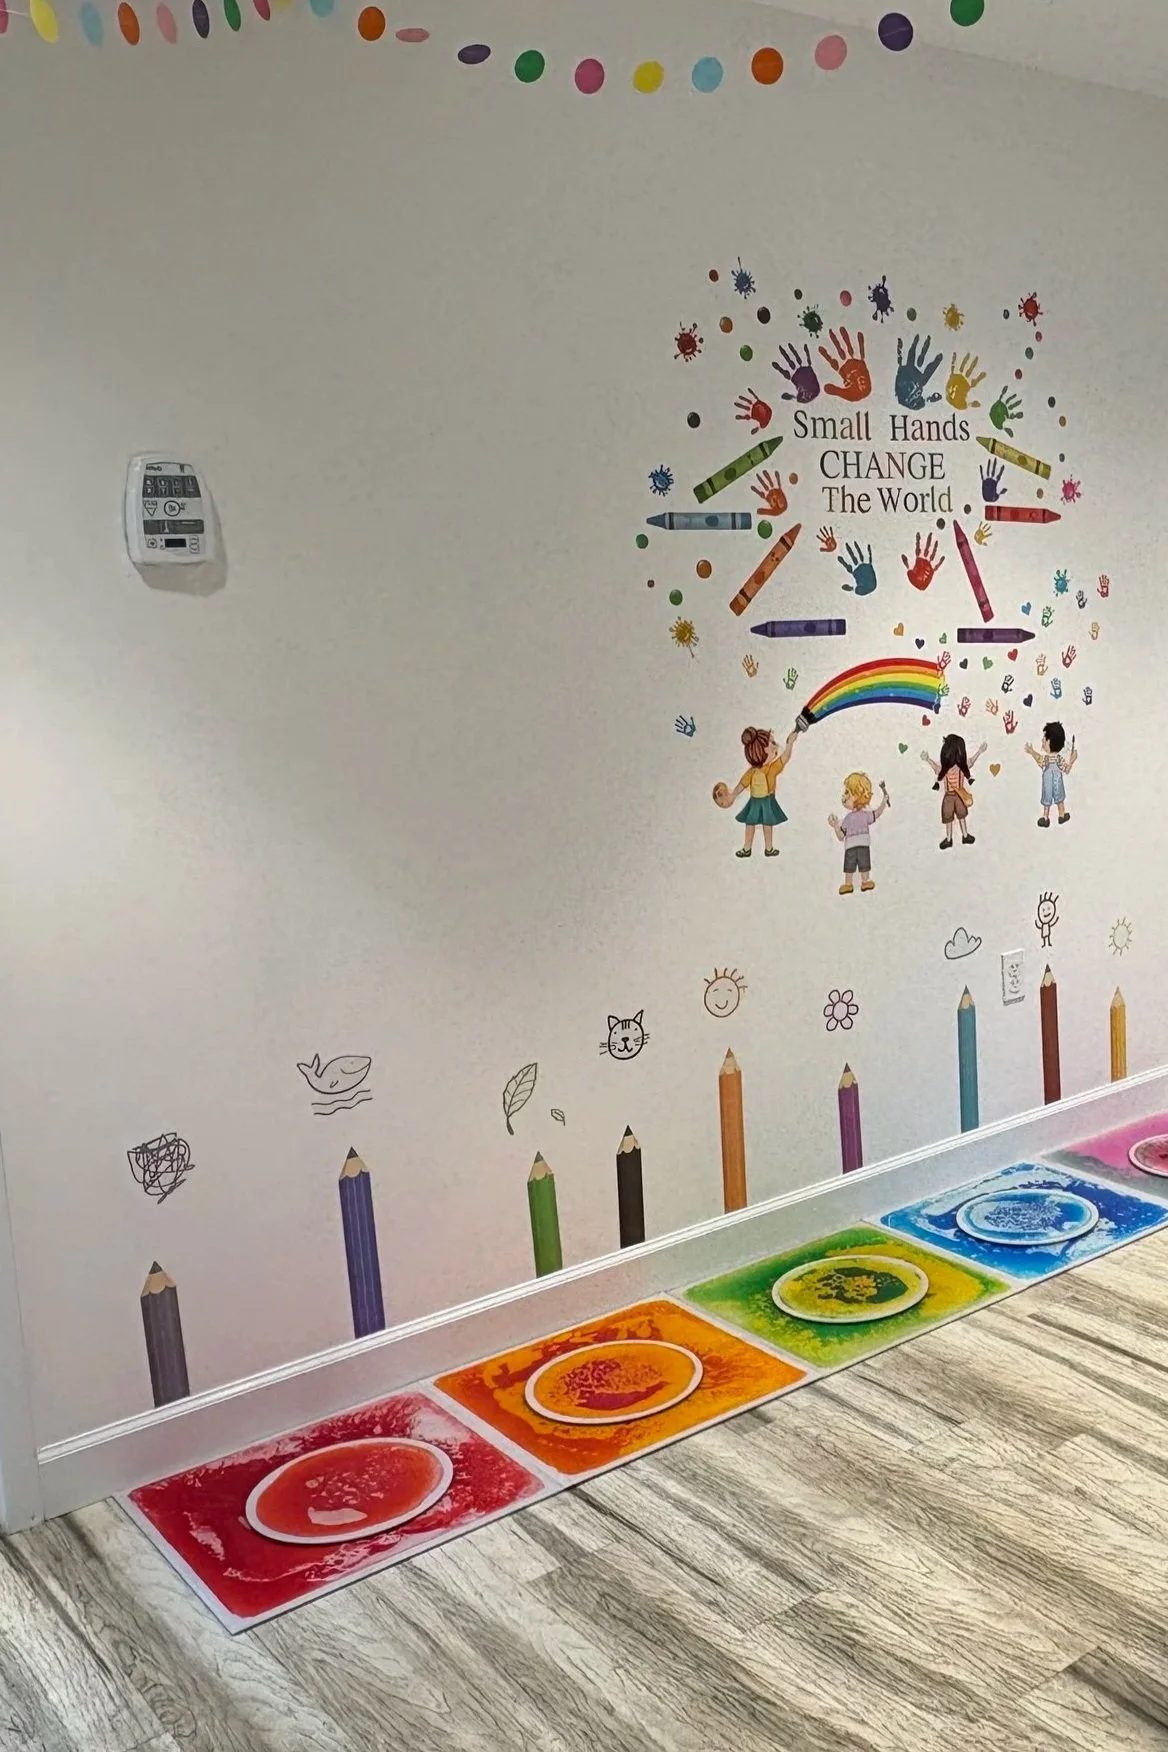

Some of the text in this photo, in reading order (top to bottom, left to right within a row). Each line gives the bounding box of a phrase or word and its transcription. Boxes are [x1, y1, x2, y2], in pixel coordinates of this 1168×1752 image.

[793, 409, 971, 442] Small Hands
[819, 450, 946, 480] CHANGE
[821, 485, 954, 514] The World
